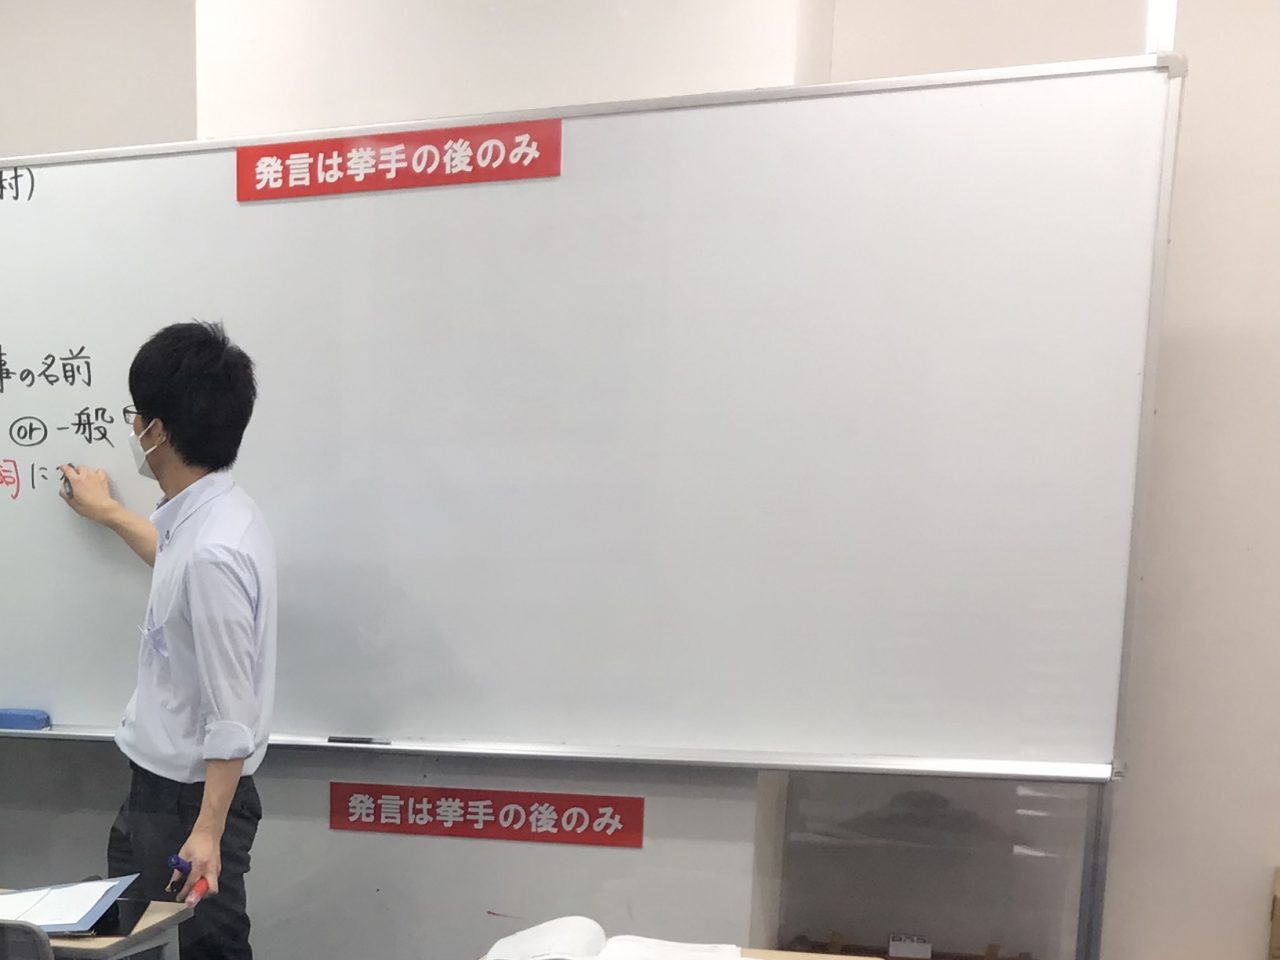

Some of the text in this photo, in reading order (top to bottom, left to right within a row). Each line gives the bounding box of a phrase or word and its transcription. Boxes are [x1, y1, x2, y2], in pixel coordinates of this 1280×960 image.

[255, 133, 540, 190] 発言は挙手の後のみ
[348, 793, 624, 836] 発言は挙手の後のみ
